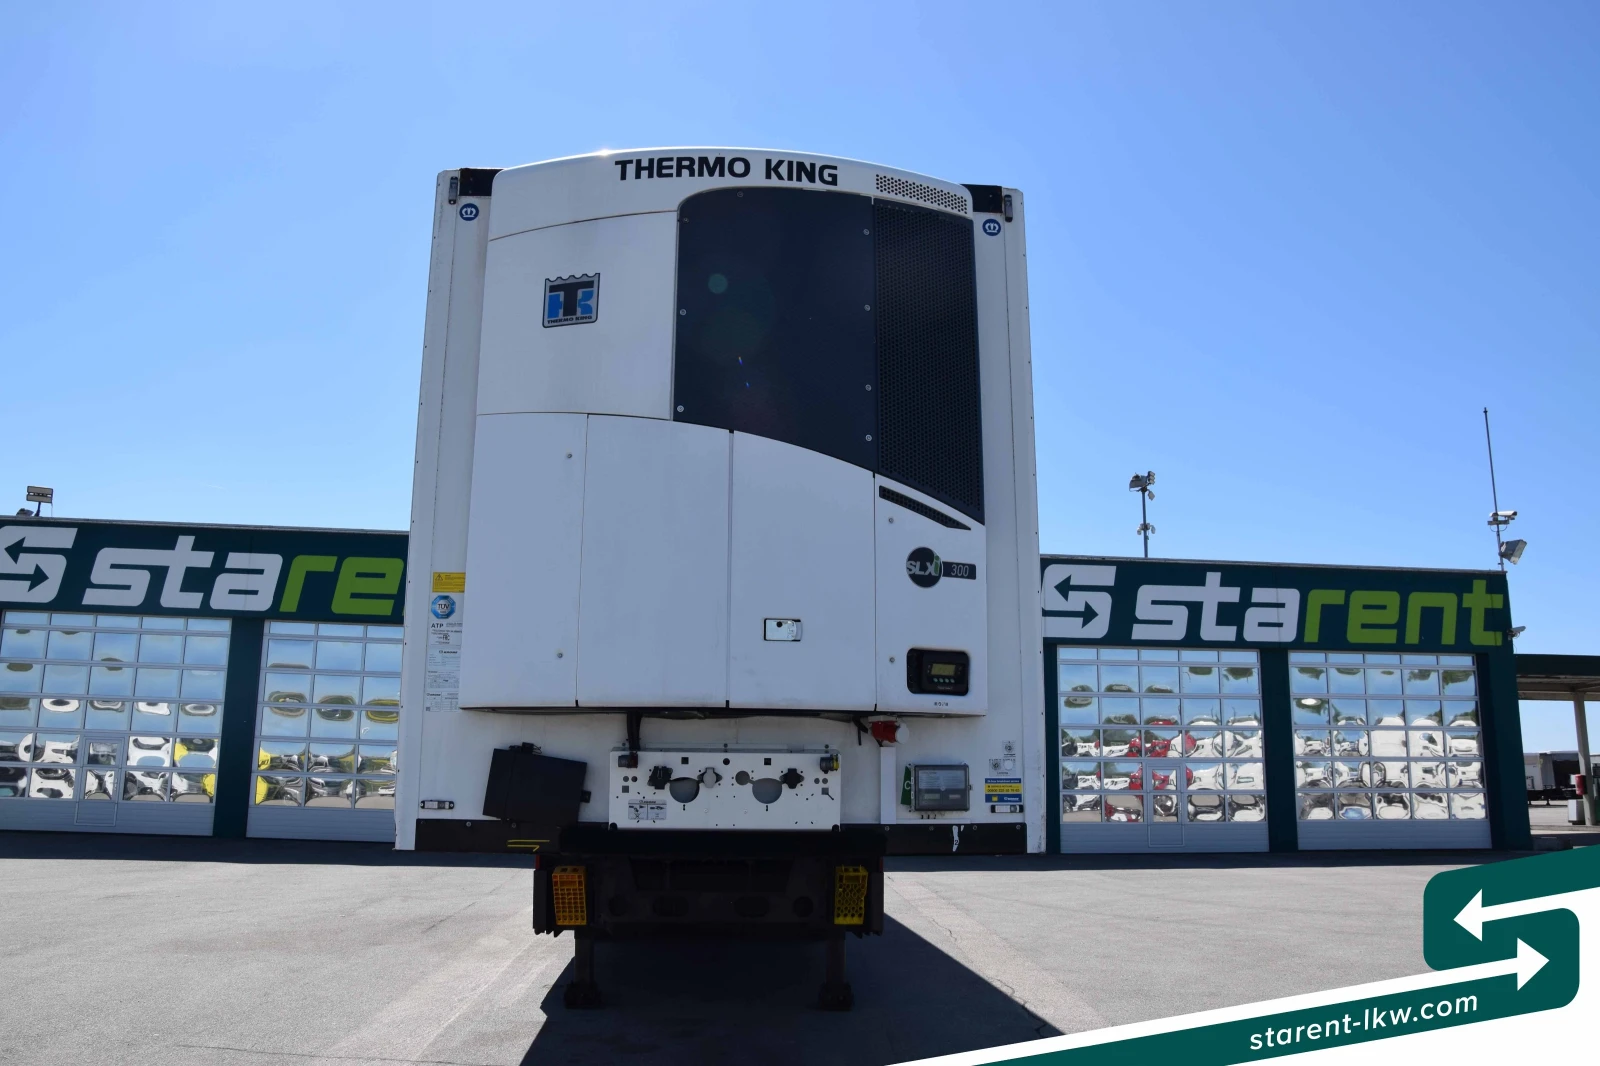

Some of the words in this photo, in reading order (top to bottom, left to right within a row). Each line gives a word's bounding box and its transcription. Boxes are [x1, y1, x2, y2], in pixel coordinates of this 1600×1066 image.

[614, 156, 751, 181] THERMO
[764, 157, 838, 187] KING
[547, 317, 574, 325] THERMO
[81, 535, 406, 617] stare
[950, 564, 969, 577] 300
[1131, 571, 1504, 646] starent
